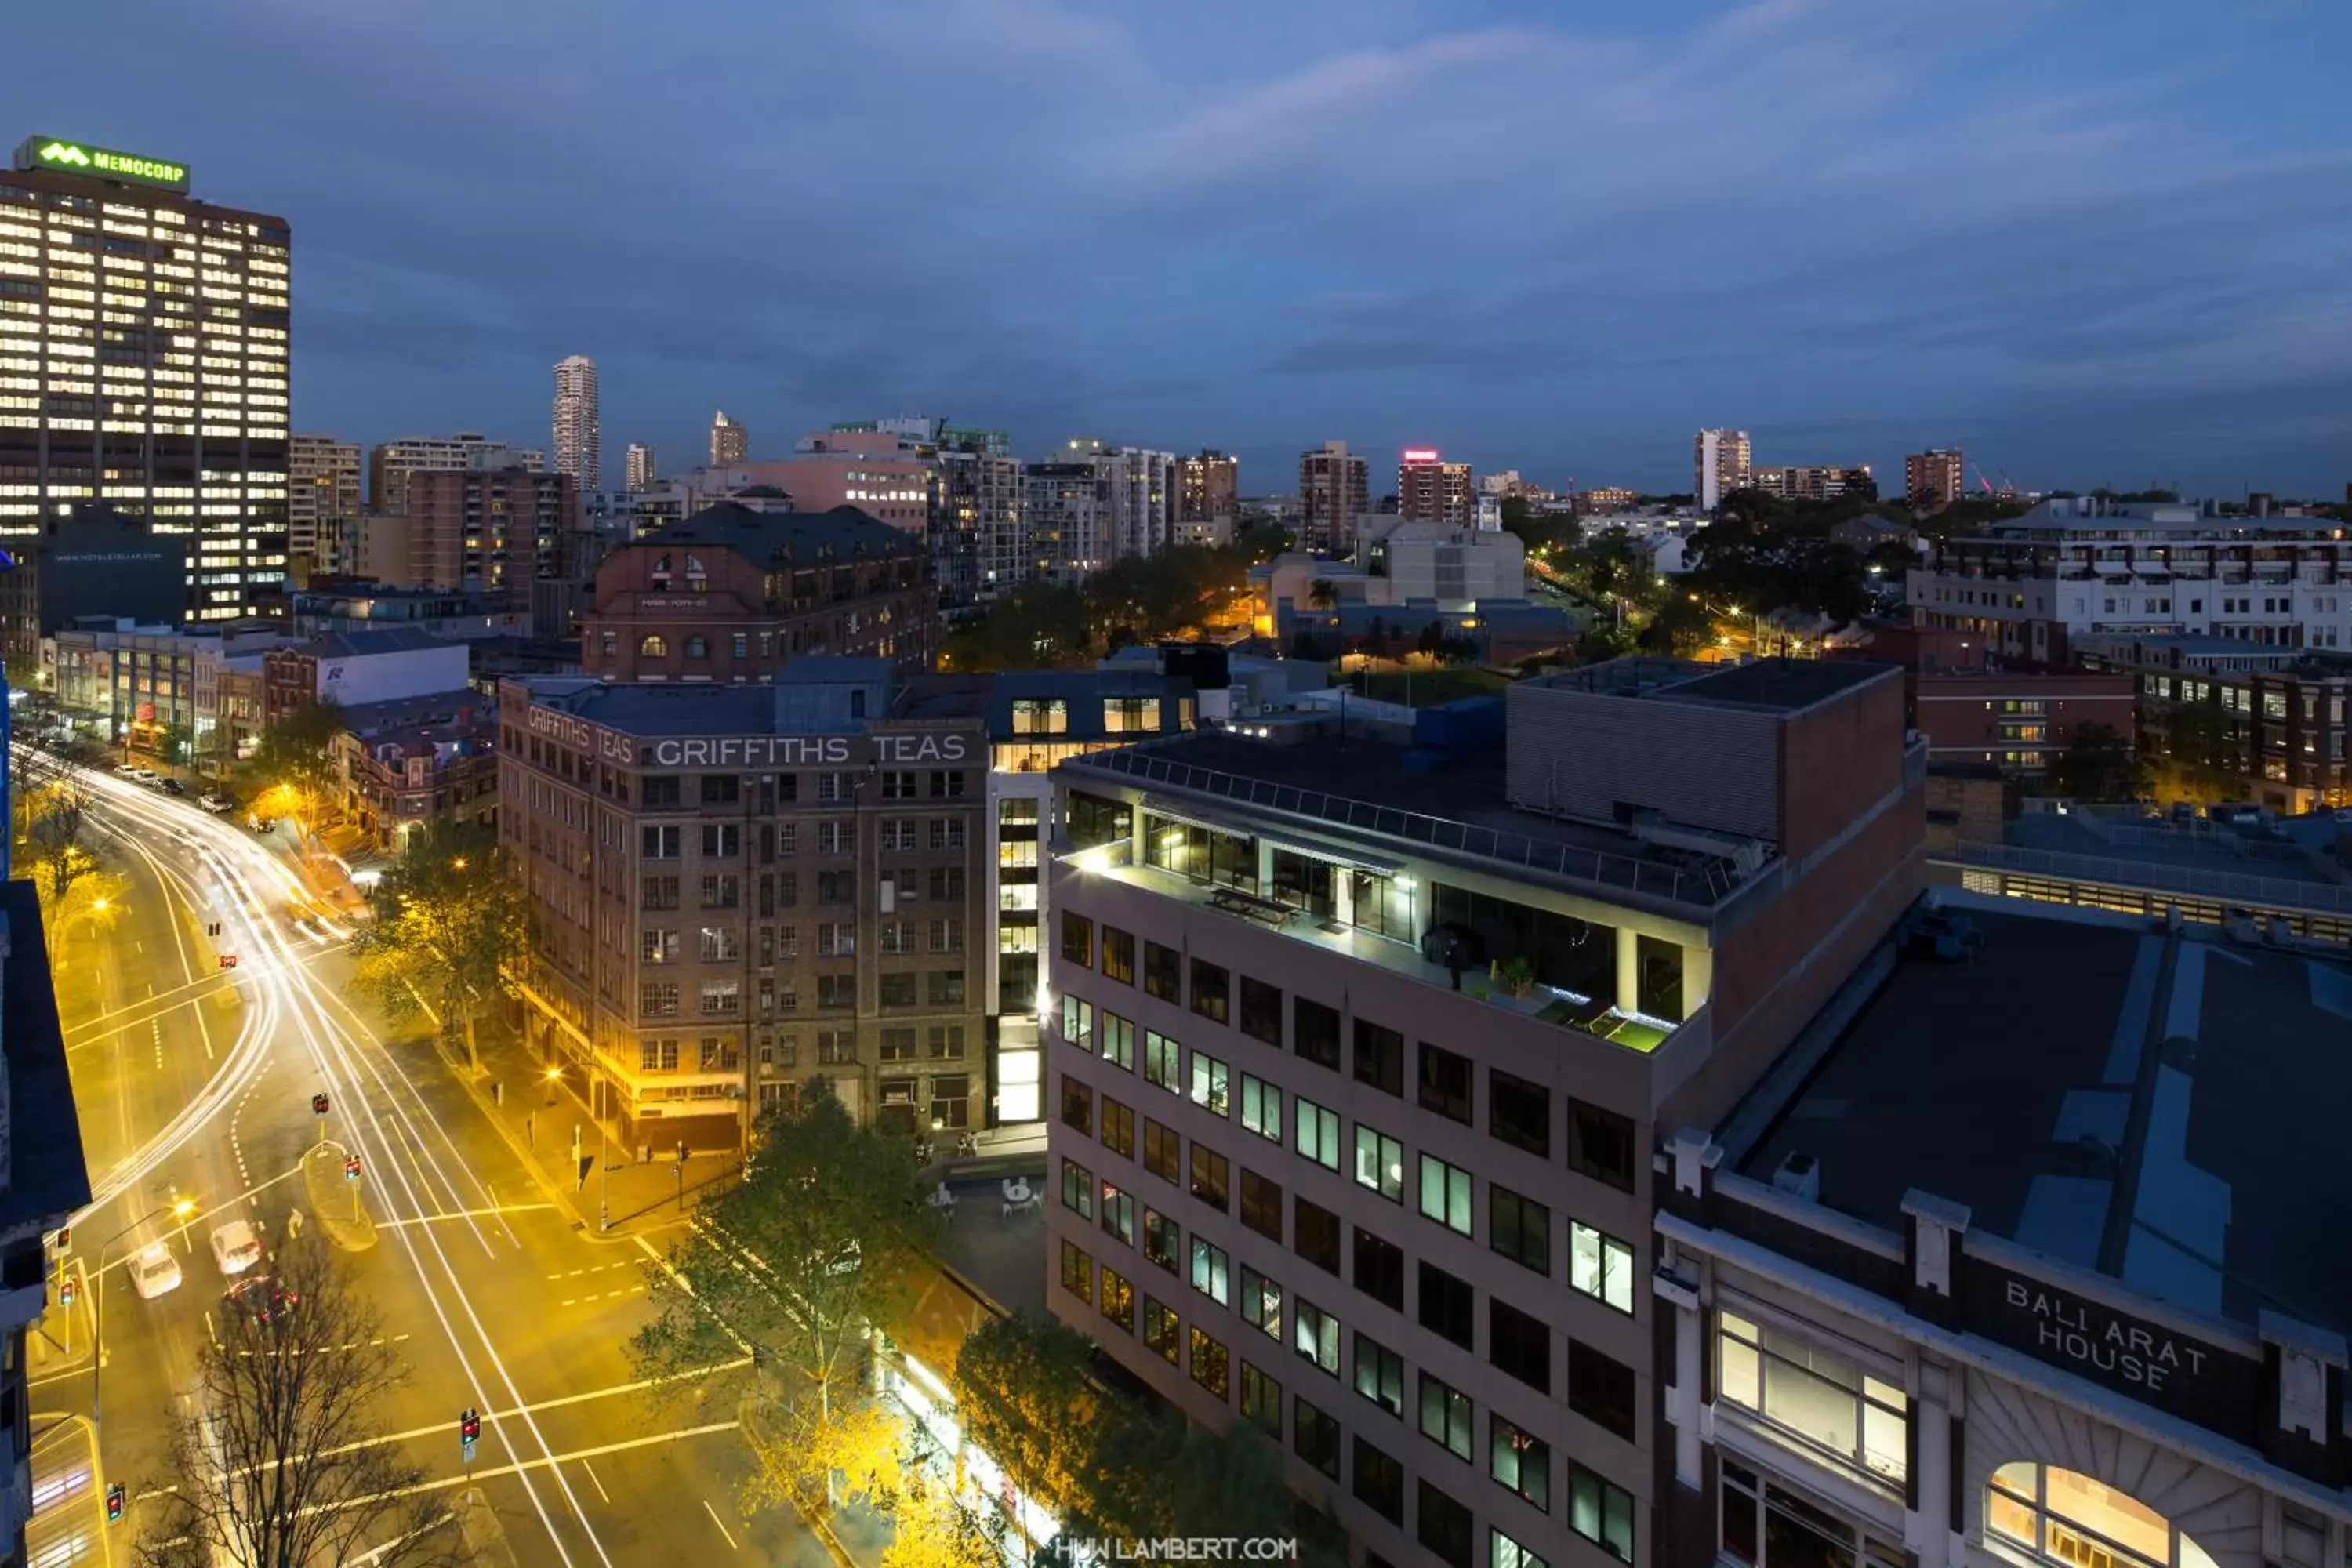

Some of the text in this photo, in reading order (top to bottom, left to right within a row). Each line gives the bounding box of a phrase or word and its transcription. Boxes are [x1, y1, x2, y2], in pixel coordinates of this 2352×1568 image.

[93, 152, 184, 181] MEMOCORP
[528, 704, 632, 764] GRIFFITHS TEAS
[656, 735, 965, 765] GRIFFITHS TEAS
[2039, 1321, 2169, 1392] HOUSE
